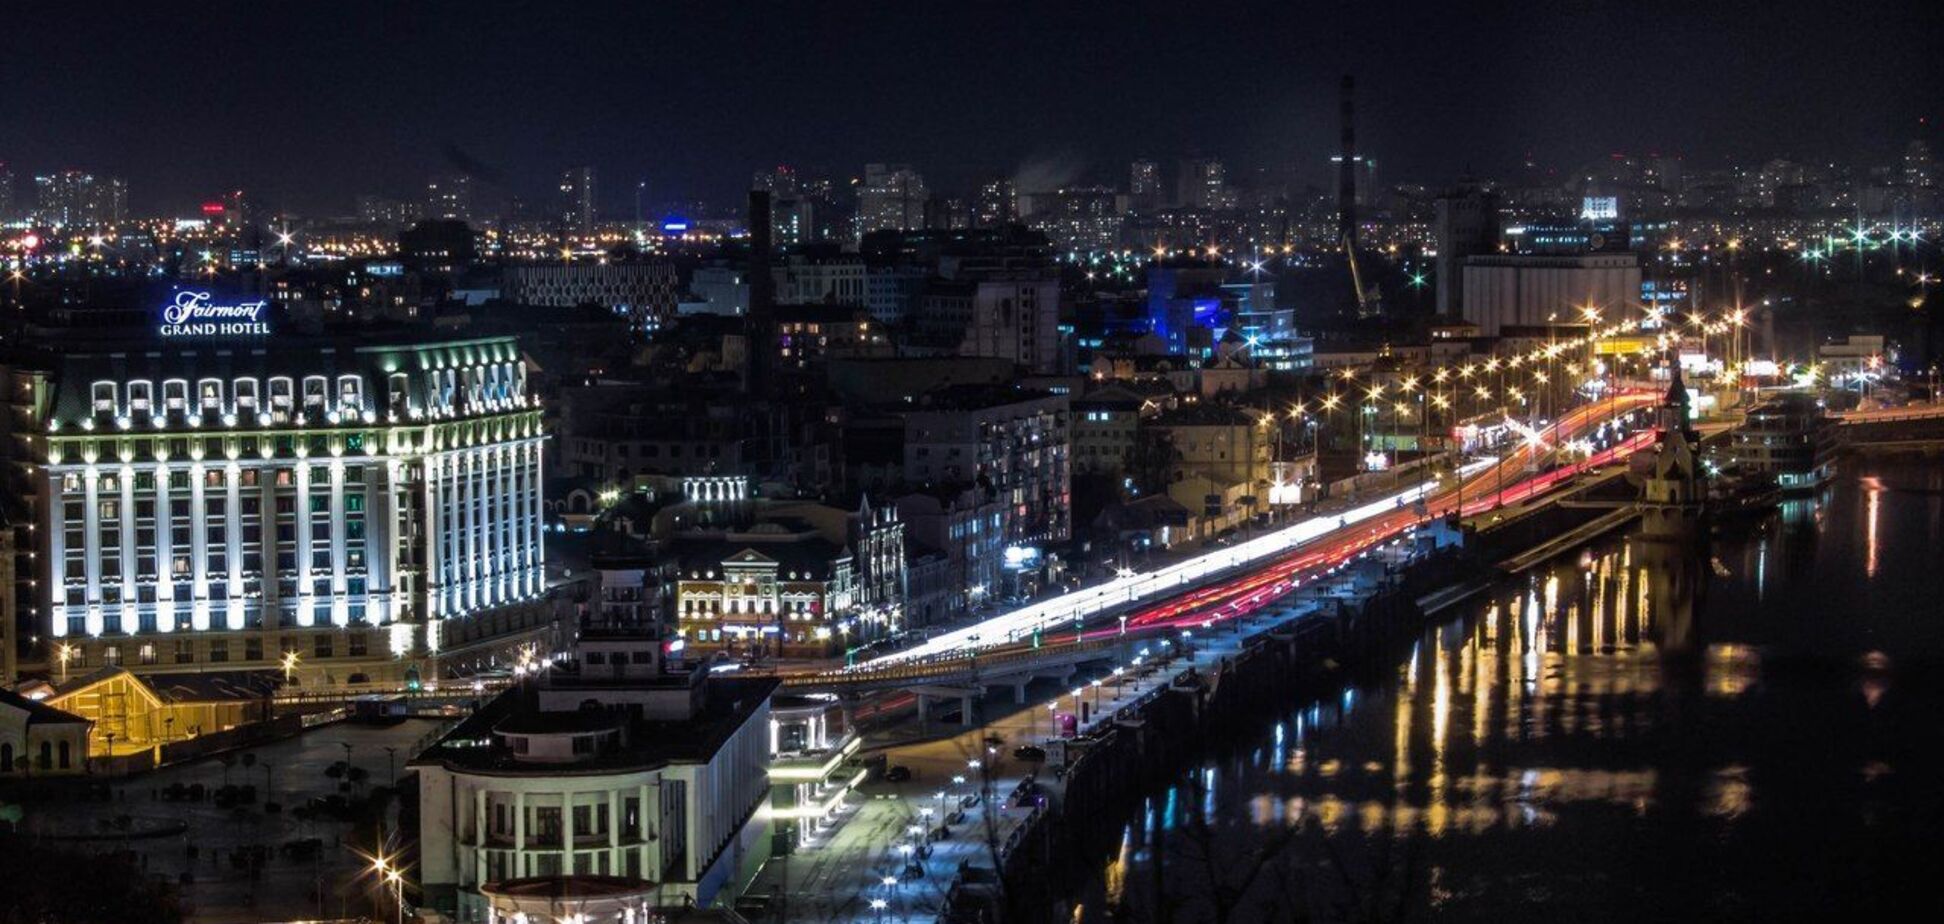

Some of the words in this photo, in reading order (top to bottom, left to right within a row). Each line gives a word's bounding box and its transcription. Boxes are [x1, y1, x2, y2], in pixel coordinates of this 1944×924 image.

[164, 291, 267, 324] Fairmont
[160, 324, 216, 335] GRAND
[221, 323, 270, 334] HOTEL
